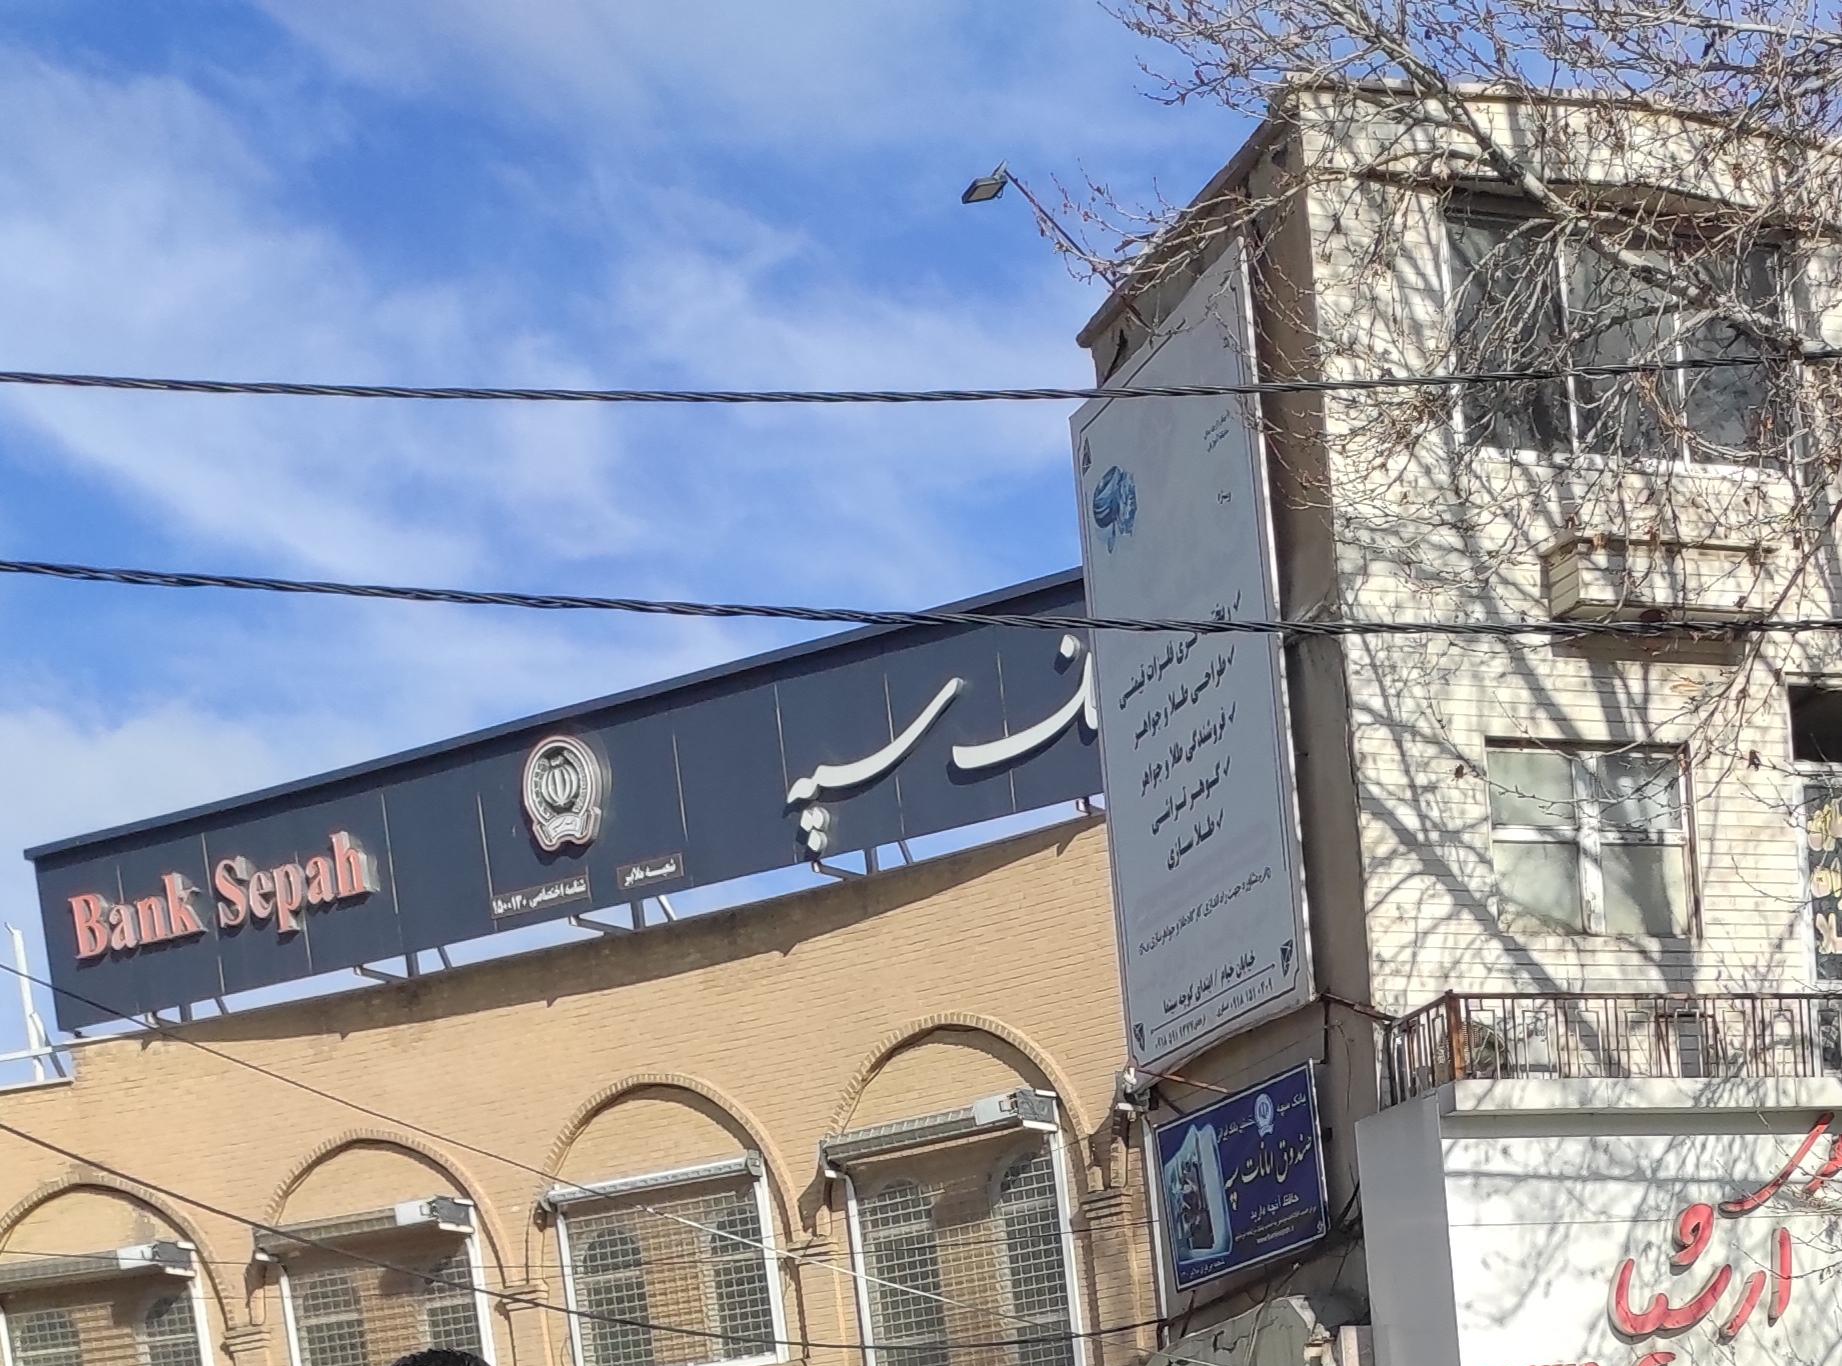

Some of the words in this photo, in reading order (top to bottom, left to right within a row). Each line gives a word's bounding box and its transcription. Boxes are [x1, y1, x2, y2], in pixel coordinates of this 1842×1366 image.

[1190, 653, 1228, 705] طراحی
[1163, 705, 1170, 728] و
[1168, 683, 1189, 717] طلا
[1134, 709, 1162, 750] جواهر
[1185, 706, 1227, 763] فروشندگی
[1164, 758, 1171, 781] و
[1168, 742, 1184, 769] طلا
[1141, 762, 1163, 798] جواهر
[1189, 759, 1221, 812] گوهر
[1193, 814, 1216, 846] طلا
[1166, 832, 1194, 871] سازی
[68, 871, 208, 960] Bank
[213, 830, 374, 934] Sepah
[1240, 1140, 1274, 1184] امانات
[1276, 1132, 1312, 1183] صندوق
